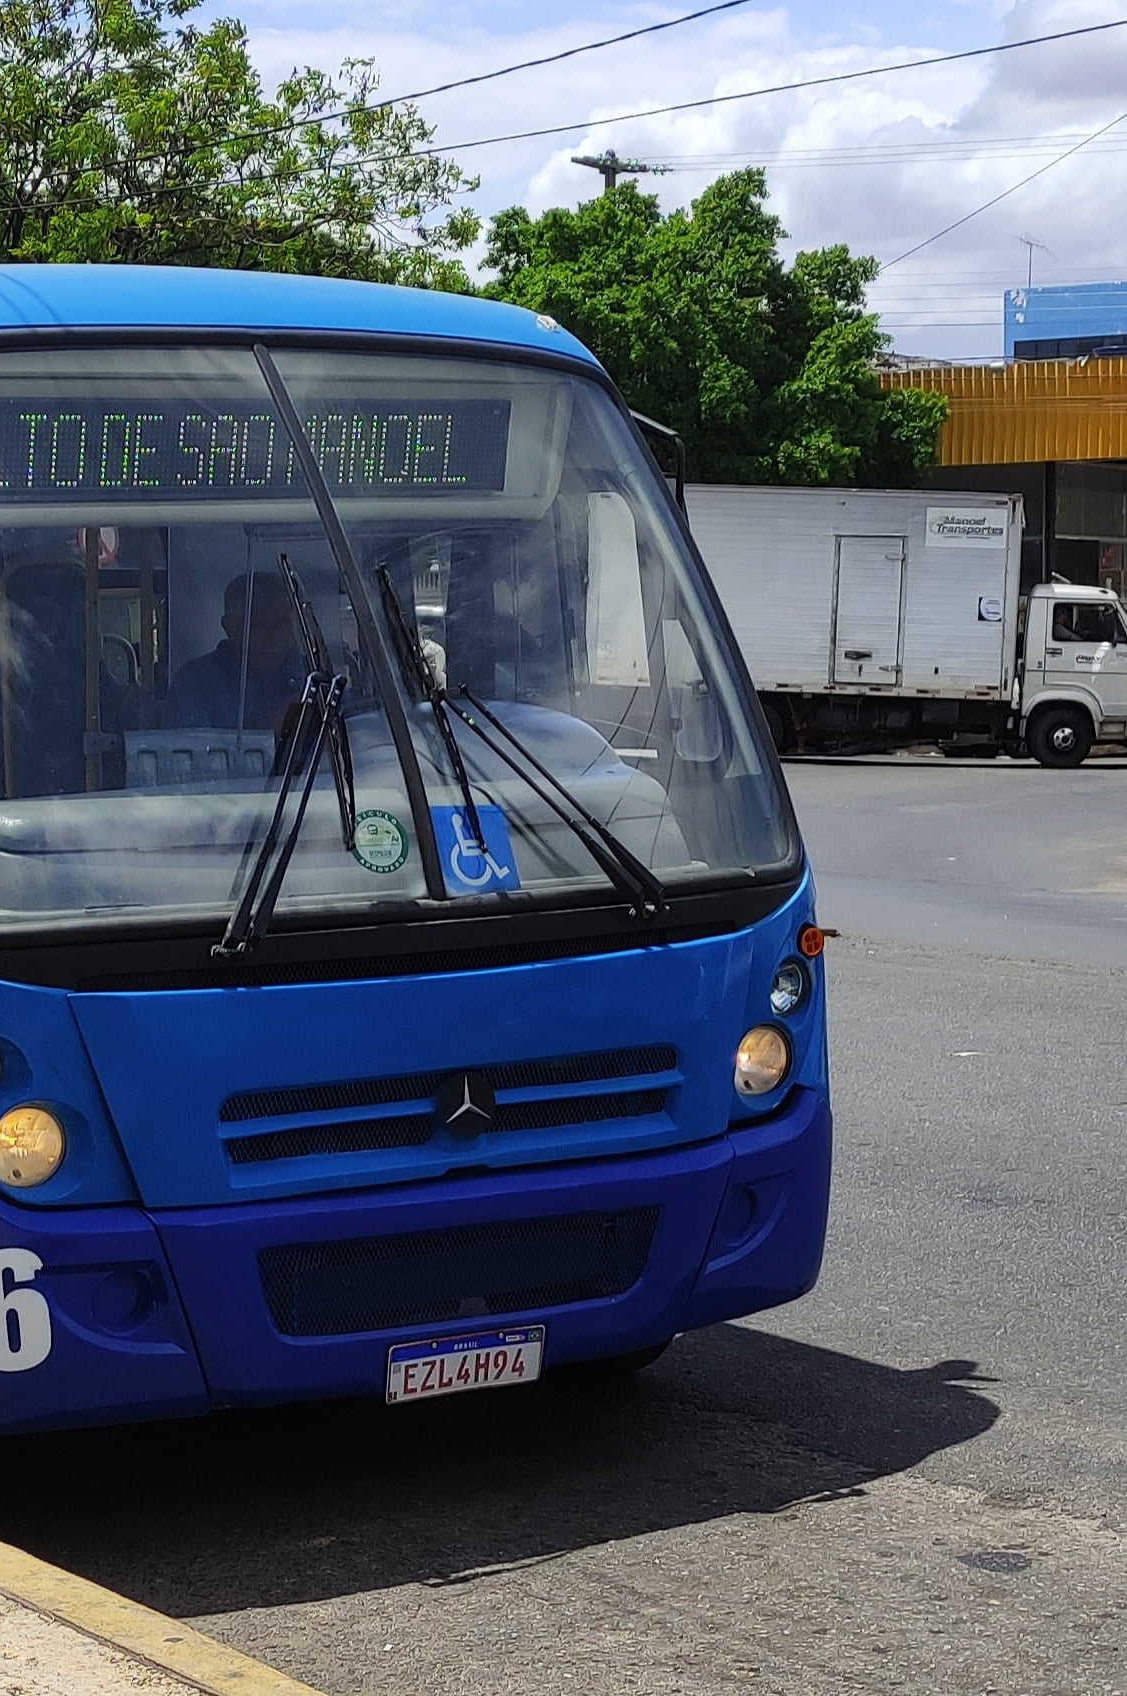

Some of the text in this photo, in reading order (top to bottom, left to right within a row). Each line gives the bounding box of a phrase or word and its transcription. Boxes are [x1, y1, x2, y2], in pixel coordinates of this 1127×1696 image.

[99, 413, 164, 487] DE
[177, 414, 275, 485] SAO
[936, 523, 1004, 536] Transportes
[453, 1340, 479, 1351] BRASIL
[402, 1347, 526, 1395] EZL4H94
